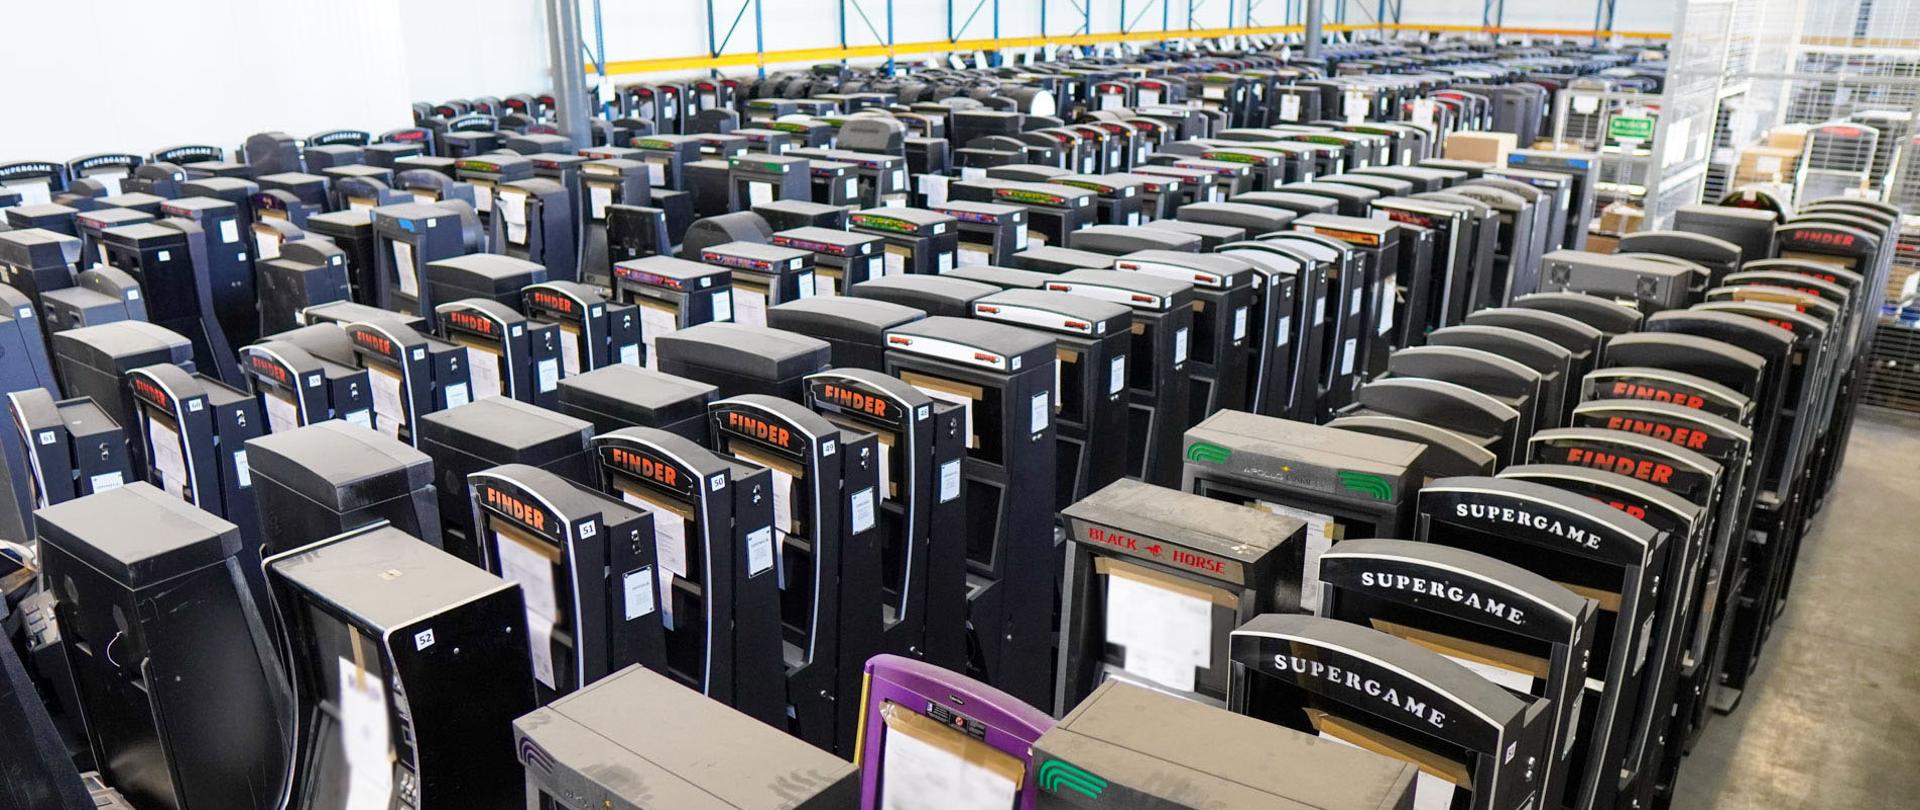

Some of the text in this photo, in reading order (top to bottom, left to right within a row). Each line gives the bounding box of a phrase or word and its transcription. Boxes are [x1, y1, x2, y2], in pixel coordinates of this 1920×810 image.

[83, 156, 130, 168] SUPERGAME
[1793, 230, 1852, 244] FINDER
[534, 292, 572, 313] FINDER
[451, 311, 491, 333] FINDER
[356, 331, 391, 354] FINDER
[252, 356, 286, 382] FINDER
[136, 379, 166, 408] FINDER
[825, 384, 887, 416] FINDER
[729, 412, 790, 448] FINDER
[1606, 416, 1709, 449] FINDER
[825, 443, 834, 453] 49
[613, 448, 678, 486] FINDER
[1567, 447, 1674, 484] FINDER
[714, 477, 724, 487] 50
[487, 487, 545, 531] FINDER
[582, 524, 594, 535] 51
[1456, 501, 1602, 550] SUPERGAME
[1088, 527, 1226, 575] BLACK HORSE
[1361, 571, 1525, 625] SUPERGAME
[419, 633, 432, 645] 52
[1274, 654, 1447, 728] SUPERGAME
